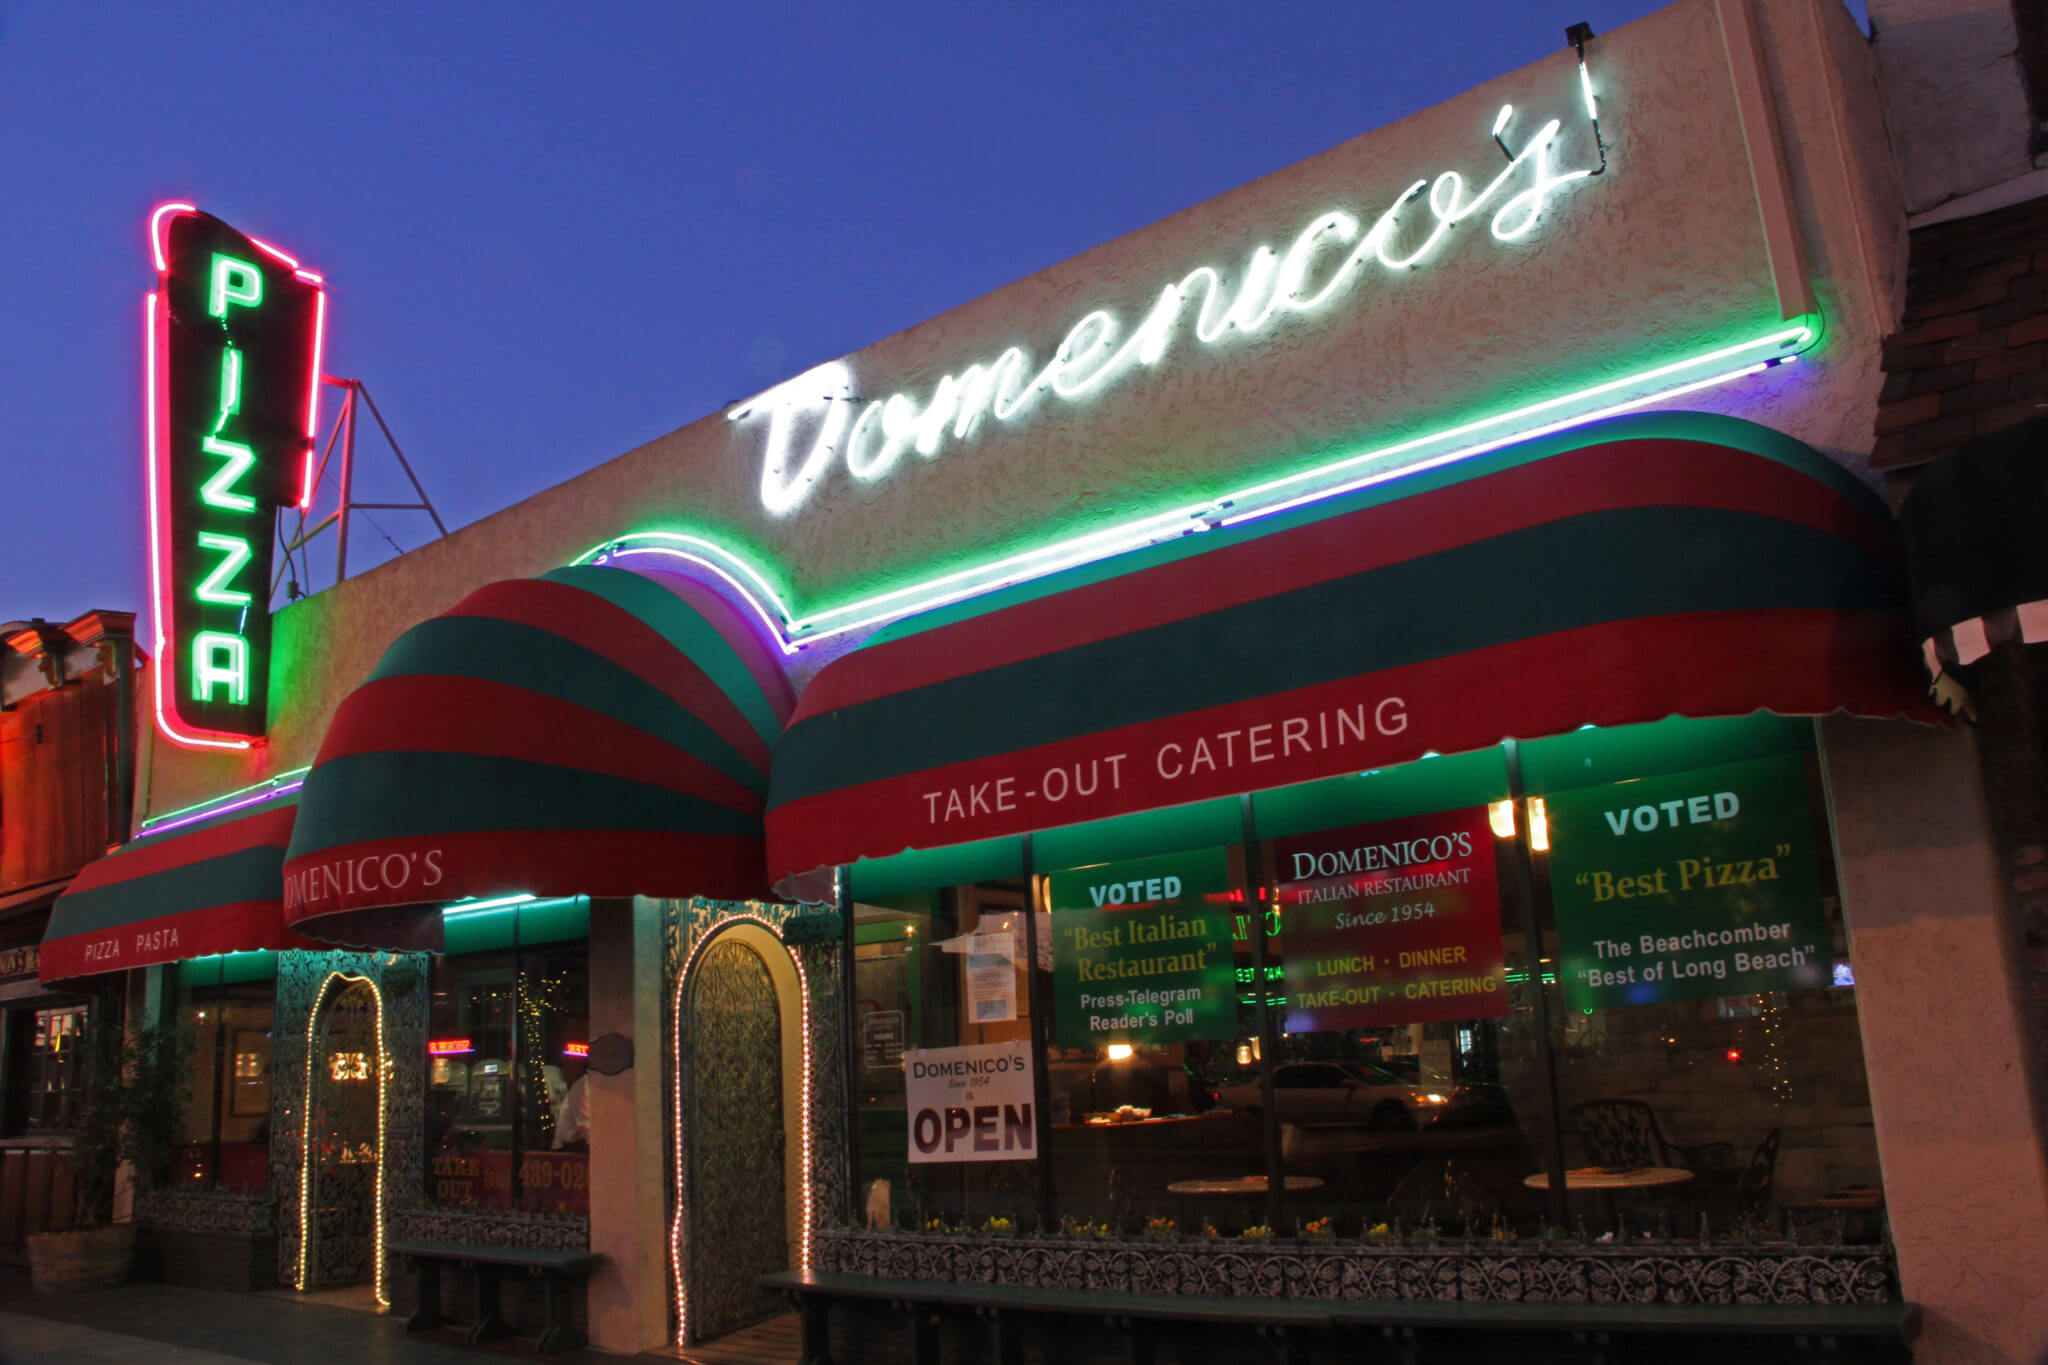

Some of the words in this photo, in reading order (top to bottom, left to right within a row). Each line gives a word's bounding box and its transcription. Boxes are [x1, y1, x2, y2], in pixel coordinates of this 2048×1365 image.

[728, 103, 1592, 515] Domenico's
[192, 251, 263, 705] PIZZA
[922, 753, 1128, 824] TAKE-OUT
[1156, 696, 1409, 780] CATERING
[1604, 791, 1740, 836] VOTED
[1292, 831, 1473, 881] DOMENICO'S
[284, 849, 443, 909] OMENICO'S
[1089, 875, 1182, 908] VOTED
[1298, 879, 1360, 905] ITALIAN
[1363, 867, 1472, 897] RESTAURANT
[1128, 914, 1209, 945] Italian
[1335, 909, 1388, 930] Since
[1391, 901, 1436, 923] 1954
[84, 938, 120, 962] PIZZA
[136, 927, 179, 953] PASTA
[1593, 940, 1632, 959] The
[1639, 922, 1792, 955] Beachcomber
[1317, 955, 1376, 977] LUNCH
[1399, 945, 1468, 968] DINNER
[1643, 958, 1664, 982] of
[1672, 954, 1727, 980] Long
[1080, 987, 1202, 1010] Press-Telegram
[1296, 986, 1382, 1010] TAKE-OUT
[1405, 975, 1498, 1001] CATERING
[1164, 1008, 1194, 1026] Poll
[913, 1102, 1034, 1154] OPEN
[437, 1180, 473, 1198] OUT
